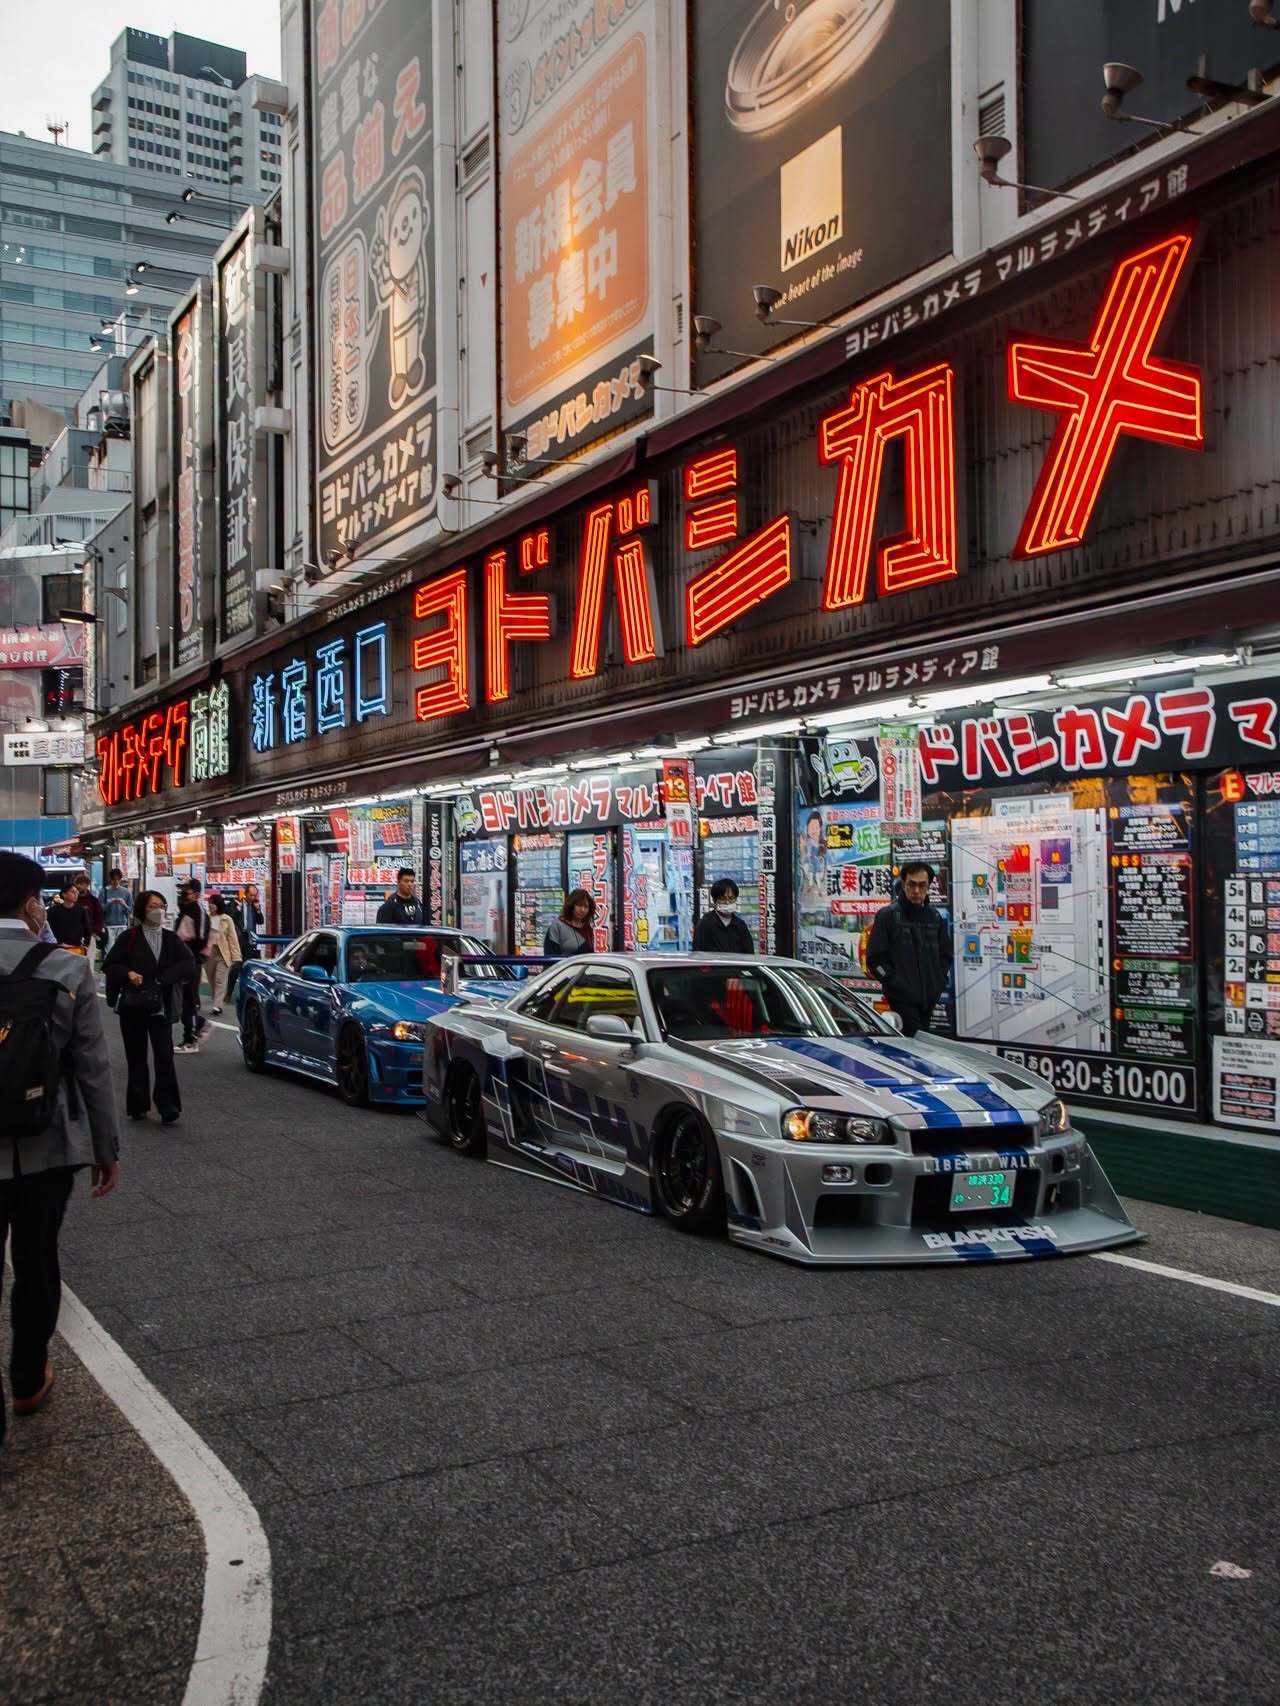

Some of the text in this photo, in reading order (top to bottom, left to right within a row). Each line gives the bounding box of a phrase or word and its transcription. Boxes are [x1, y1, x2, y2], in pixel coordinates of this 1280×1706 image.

[320, 55, 427, 241] 品揃え
[514, 119, 638, 285] 新規会員
[784, 214, 840, 267] Nikon
[527, 226, 618, 351] 募集中
[821, 263, 836, 283] the
[836, 247, 864, 275] image
[845, 163, 1188, 359] ヨドバシカメラ マルチメディア館
[224, 250, 249, 572] 延長保証
[527, 359, 645, 462] ヨドバシカメラ
[322, 412, 433, 525] ヨドバシカメラ
[336, 461, 433, 548] マルチメディア館
[253, 621, 387, 753] 新宿西口
[730, 646, 1000, 719] ヨドバシカメラ マルチメディア館
[914, 686, 1219, 786] ドバシカメラ
[480, 774, 614, 832] ヨドバシカメラ
[1225, 773, 1241, 799] E
[827, 864, 892, 897] 試乗体験
[1114, 1066, 1186, 1104] 10:00
[923, 1155, 1038, 1173] LIBERTY WALK
[990, 1185, 1011, 1206] 34
[921, 1225, 1059, 1249] BLACKFISH
